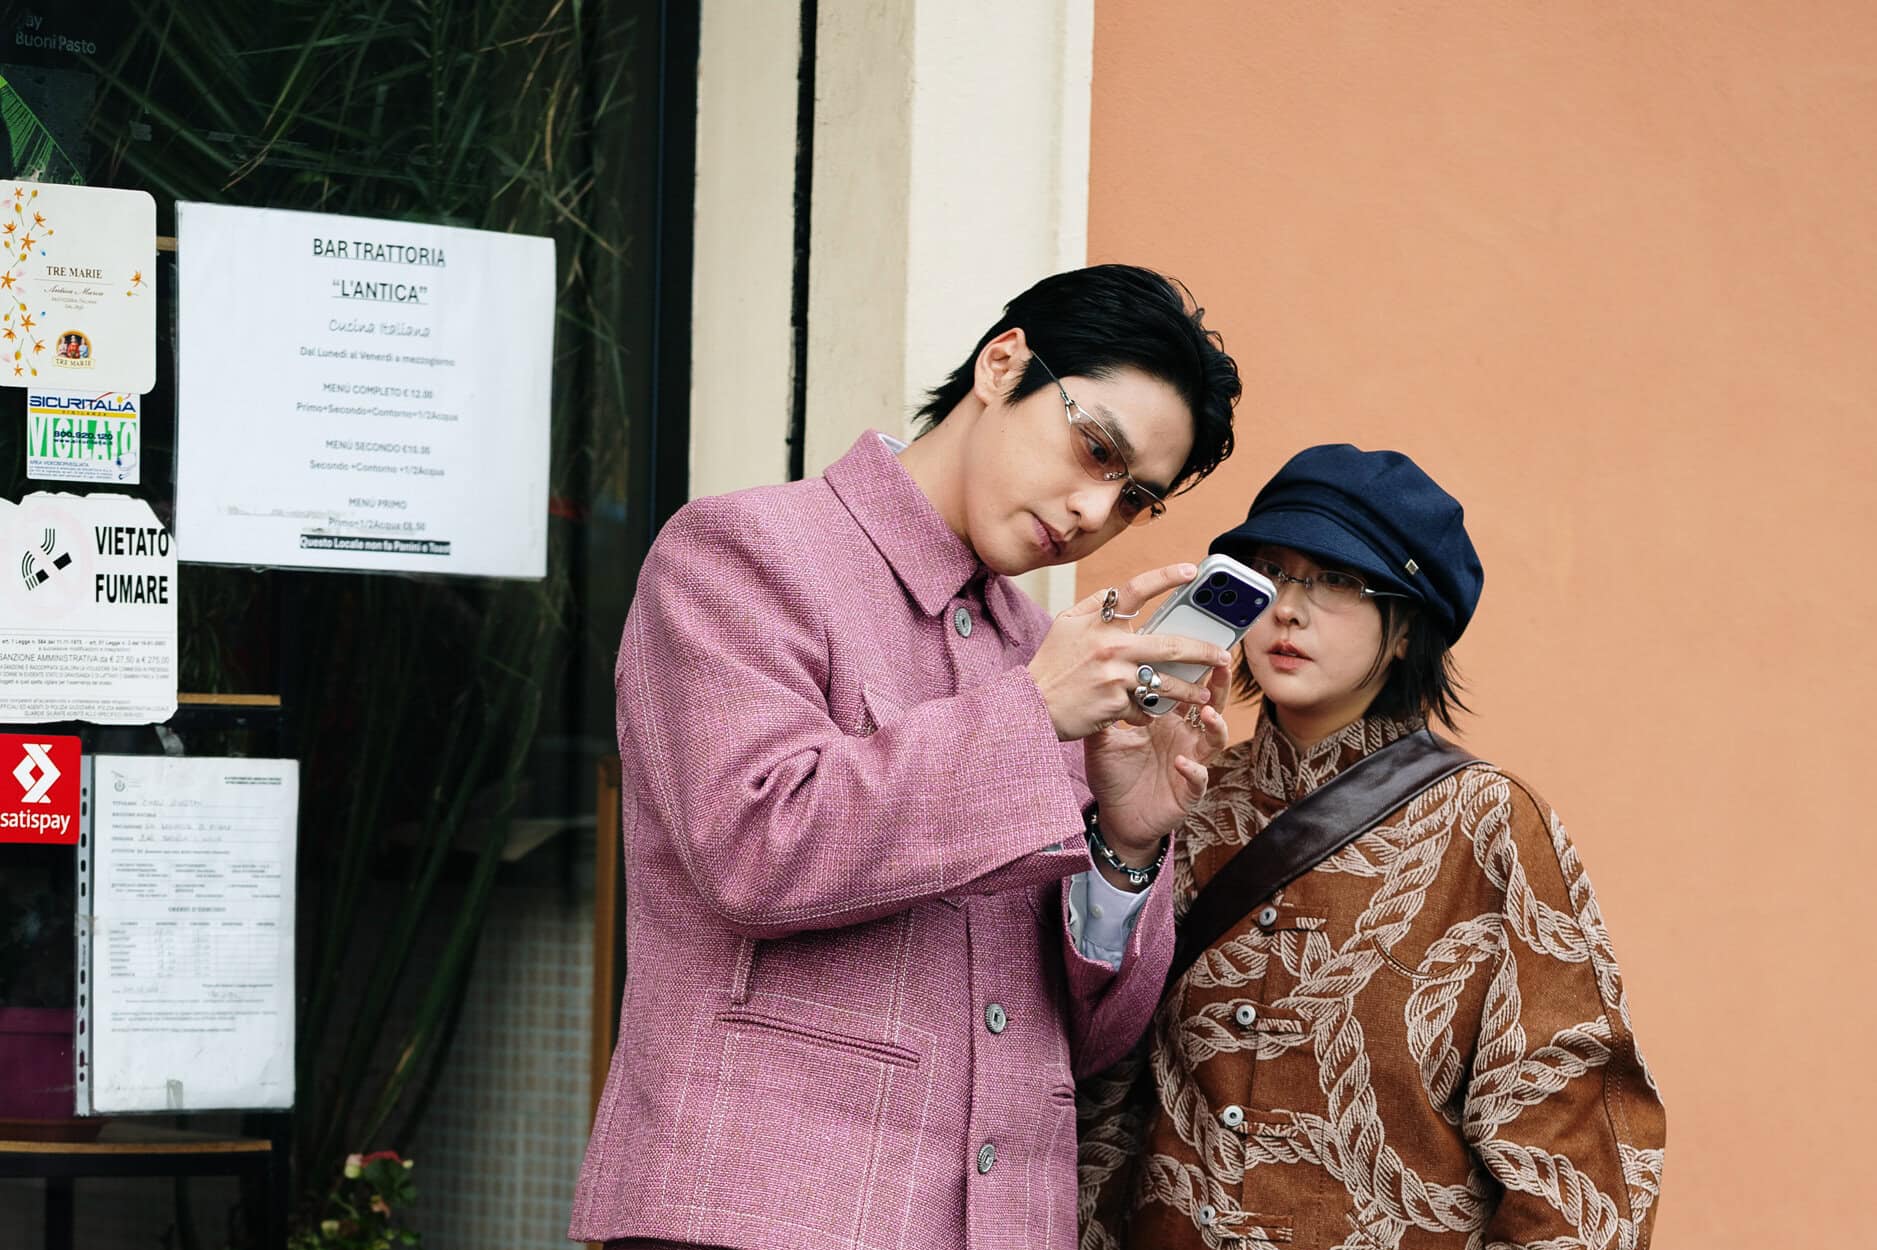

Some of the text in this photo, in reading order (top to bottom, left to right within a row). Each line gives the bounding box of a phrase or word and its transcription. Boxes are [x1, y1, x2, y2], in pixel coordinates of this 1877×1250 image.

[313, 238, 446, 266] BAR TRATTORIA
[46, 266, 103, 279] TRE MARIE
[329, 318, 431, 338] Cucina Italiana
[300, 346, 315, 356] Dal
[56, 358, 92, 368] TRE MARIE
[352, 385, 401, 398] COMPLETO
[29, 416, 137, 460] VIGILATO
[355, 441, 401, 453] SECONDO
[310, 459, 349, 471] Secondo
[377, 499, 407, 510] PRIMO
[95, 526, 169, 557] VIETATO
[301, 536, 332, 549] Questo
[334, 537, 363, 550] Locale
[95, 574, 168, 604] FUMARE
[0, 653, 35, 662] SANZIONE
[37, 653, 98, 663] AMMINISTRATIVA
[0, 809, 71, 836] satispay
